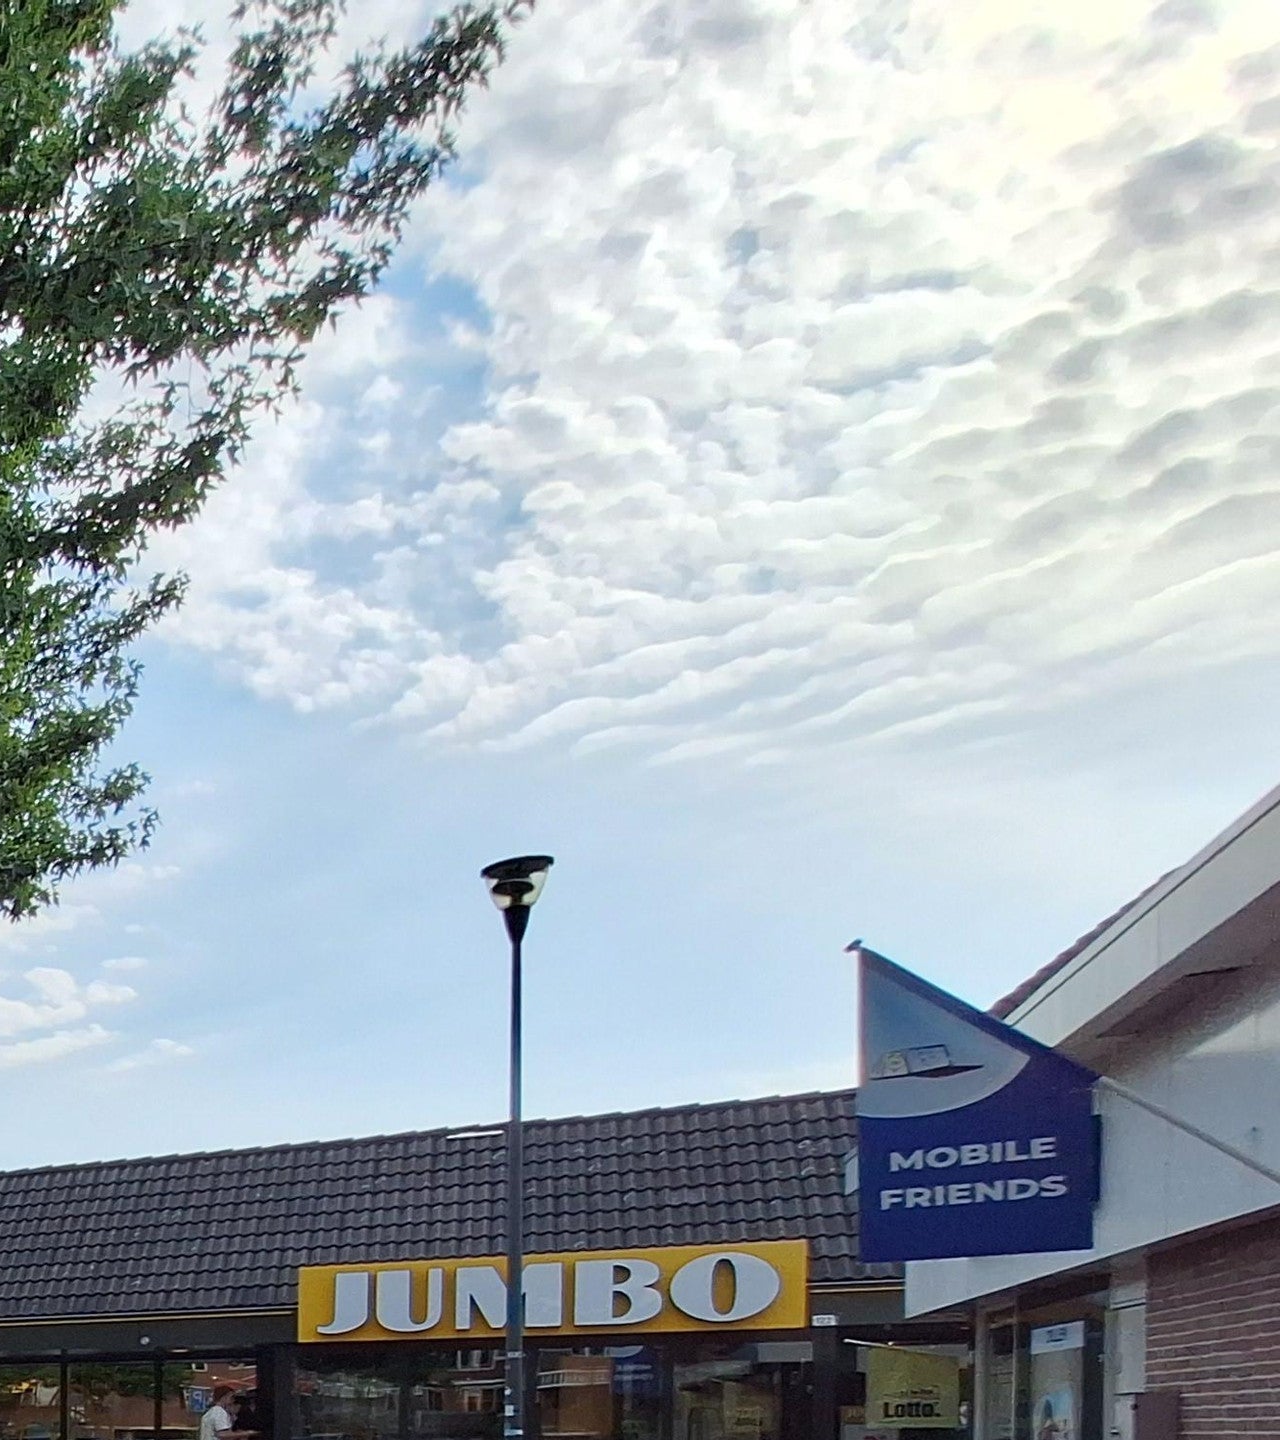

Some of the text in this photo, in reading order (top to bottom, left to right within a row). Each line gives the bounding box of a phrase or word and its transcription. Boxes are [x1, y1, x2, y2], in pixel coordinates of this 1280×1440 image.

[889, 1137, 1057, 1172] MOBILE
[880, 1175, 1067, 1211] FRIENDS
[316, 1251, 780, 1335] JUMBO
